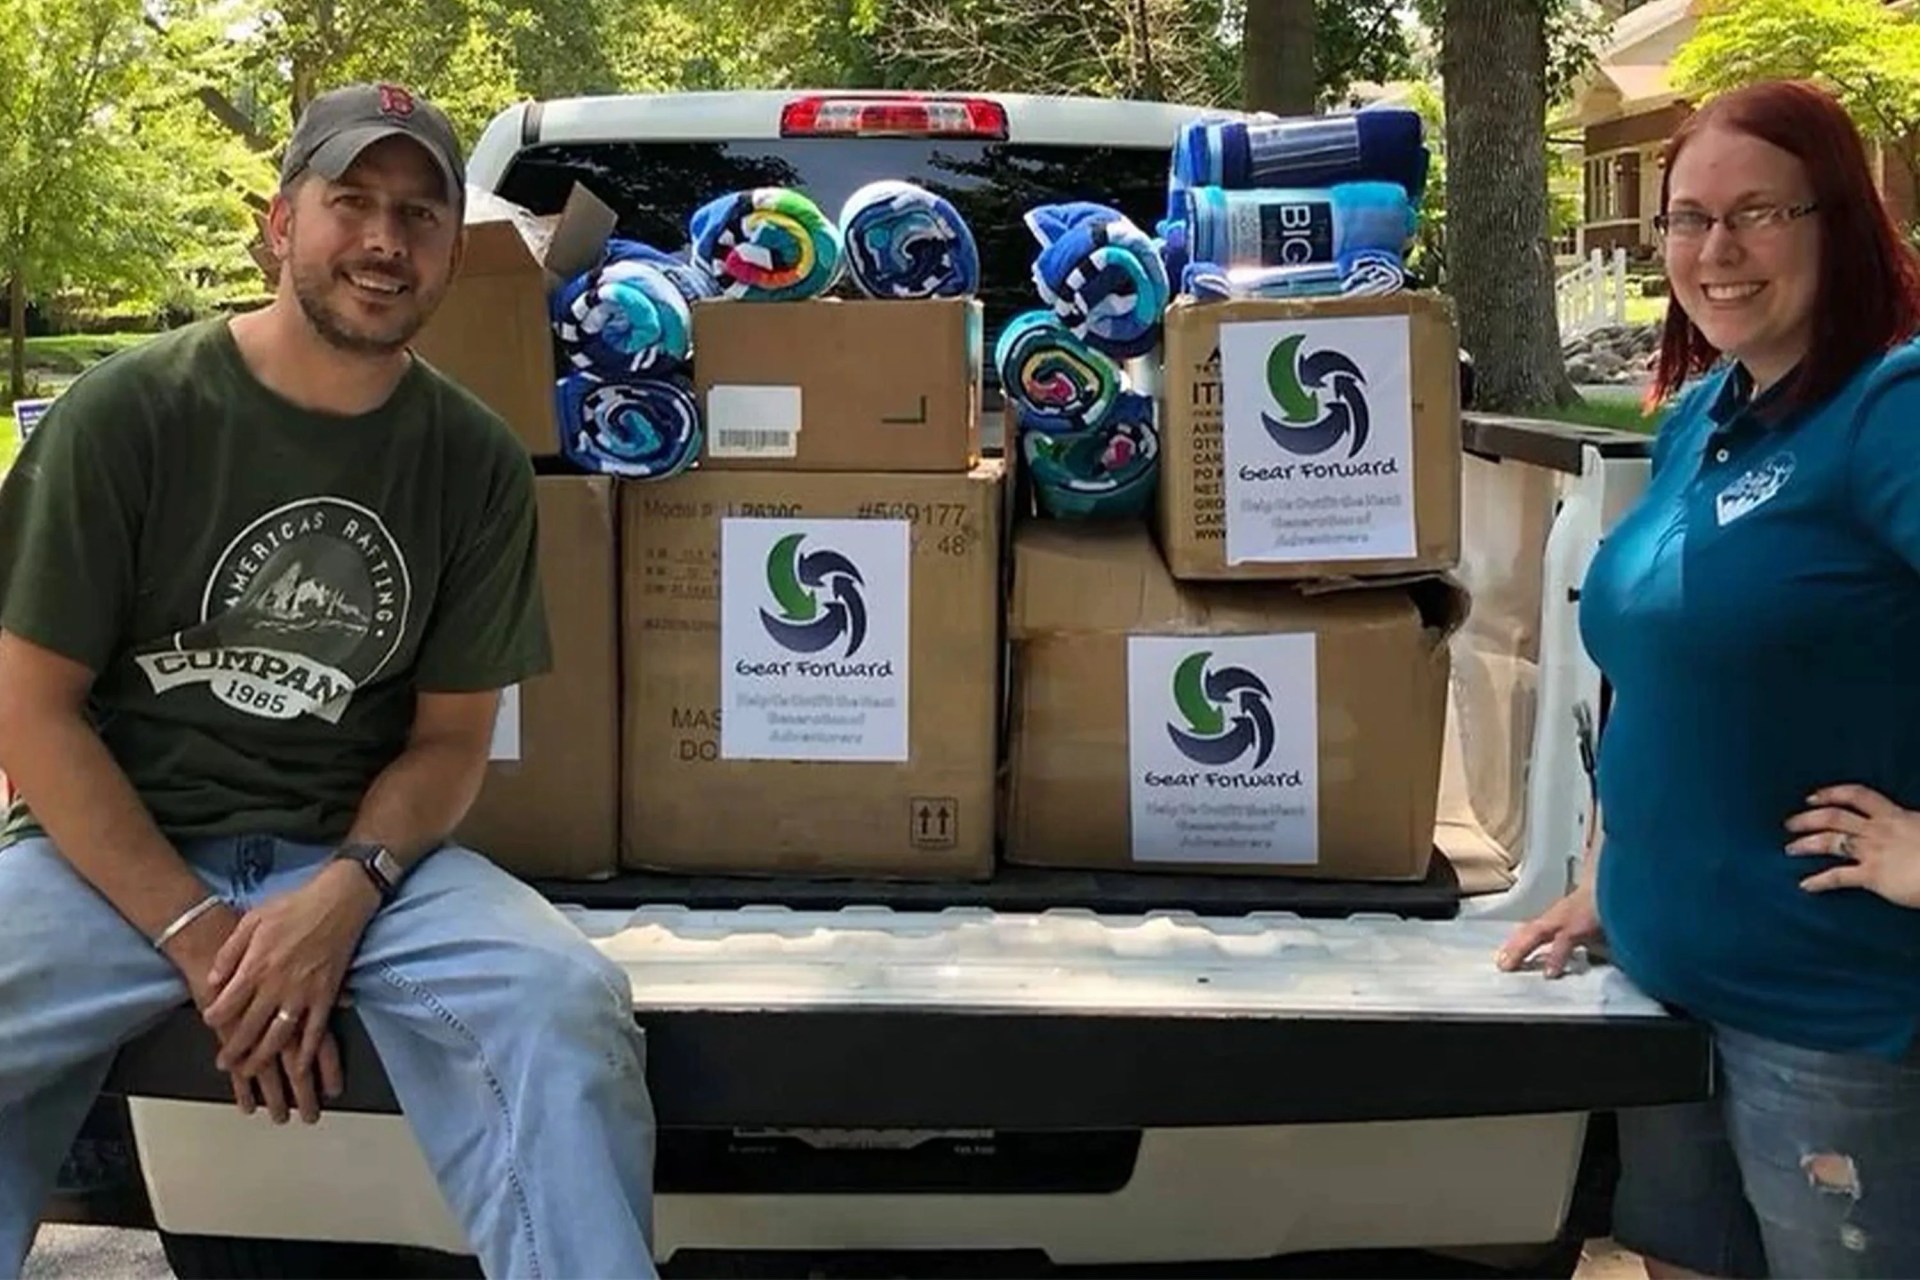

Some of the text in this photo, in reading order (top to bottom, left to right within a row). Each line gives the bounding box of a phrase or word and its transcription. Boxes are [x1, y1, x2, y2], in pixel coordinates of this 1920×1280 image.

[1281, 205, 1312, 264] BIG
[1239, 458, 1399, 481] Gear Forward
[224, 511, 395, 623] AMERICAS RAFTING
[736, 659, 893, 677] Gear Forward
[225, 679, 288, 714] 1985
[1145, 769, 1303, 788] Gear Forward
